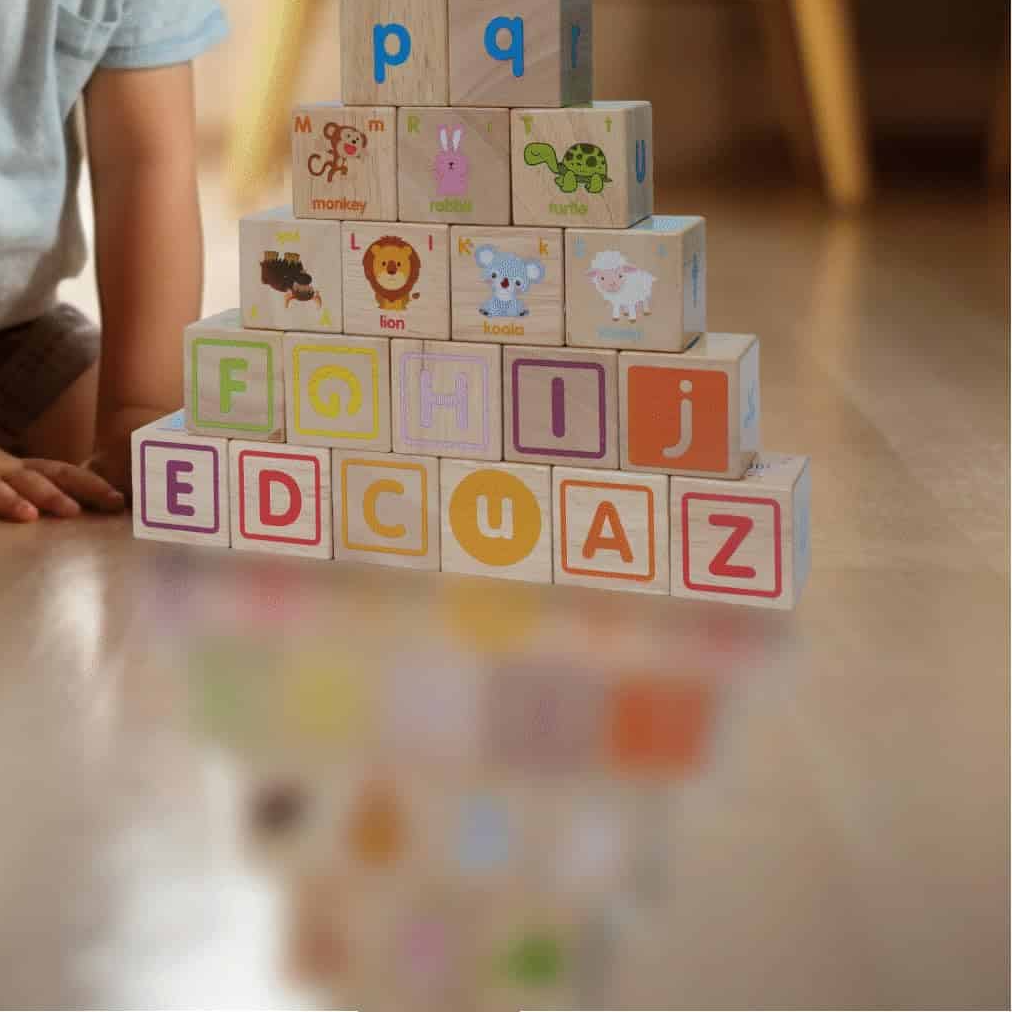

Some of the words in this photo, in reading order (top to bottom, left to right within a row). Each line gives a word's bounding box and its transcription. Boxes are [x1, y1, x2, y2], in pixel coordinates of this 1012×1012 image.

[372, 22, 412, 85] p
[483, 15, 525, 78] q
[294, 115, 313, 134] M
[367, 119, 385, 133] m
[407, 115, 421, 134] R
[312, 195, 367, 215] monkey
[349, 233, 361, 251] L
[457, 237, 473, 256] K
[379, 314, 406, 330] lion
[482, 321, 526, 337] koala
[219, 357, 250, 414] F
[307, 364, 363, 419] G
[419, 368, 469, 431] H
[551, 376, 566, 439] I
[661, 379, 693, 459] j
[166, 459, 196, 517] E
[258, 469, 303, 527] D
[362, 478, 407, 538] C
[475, 494, 514, 540] u
[581, 500, 635, 564] A
[707, 513, 757, 580] Z
